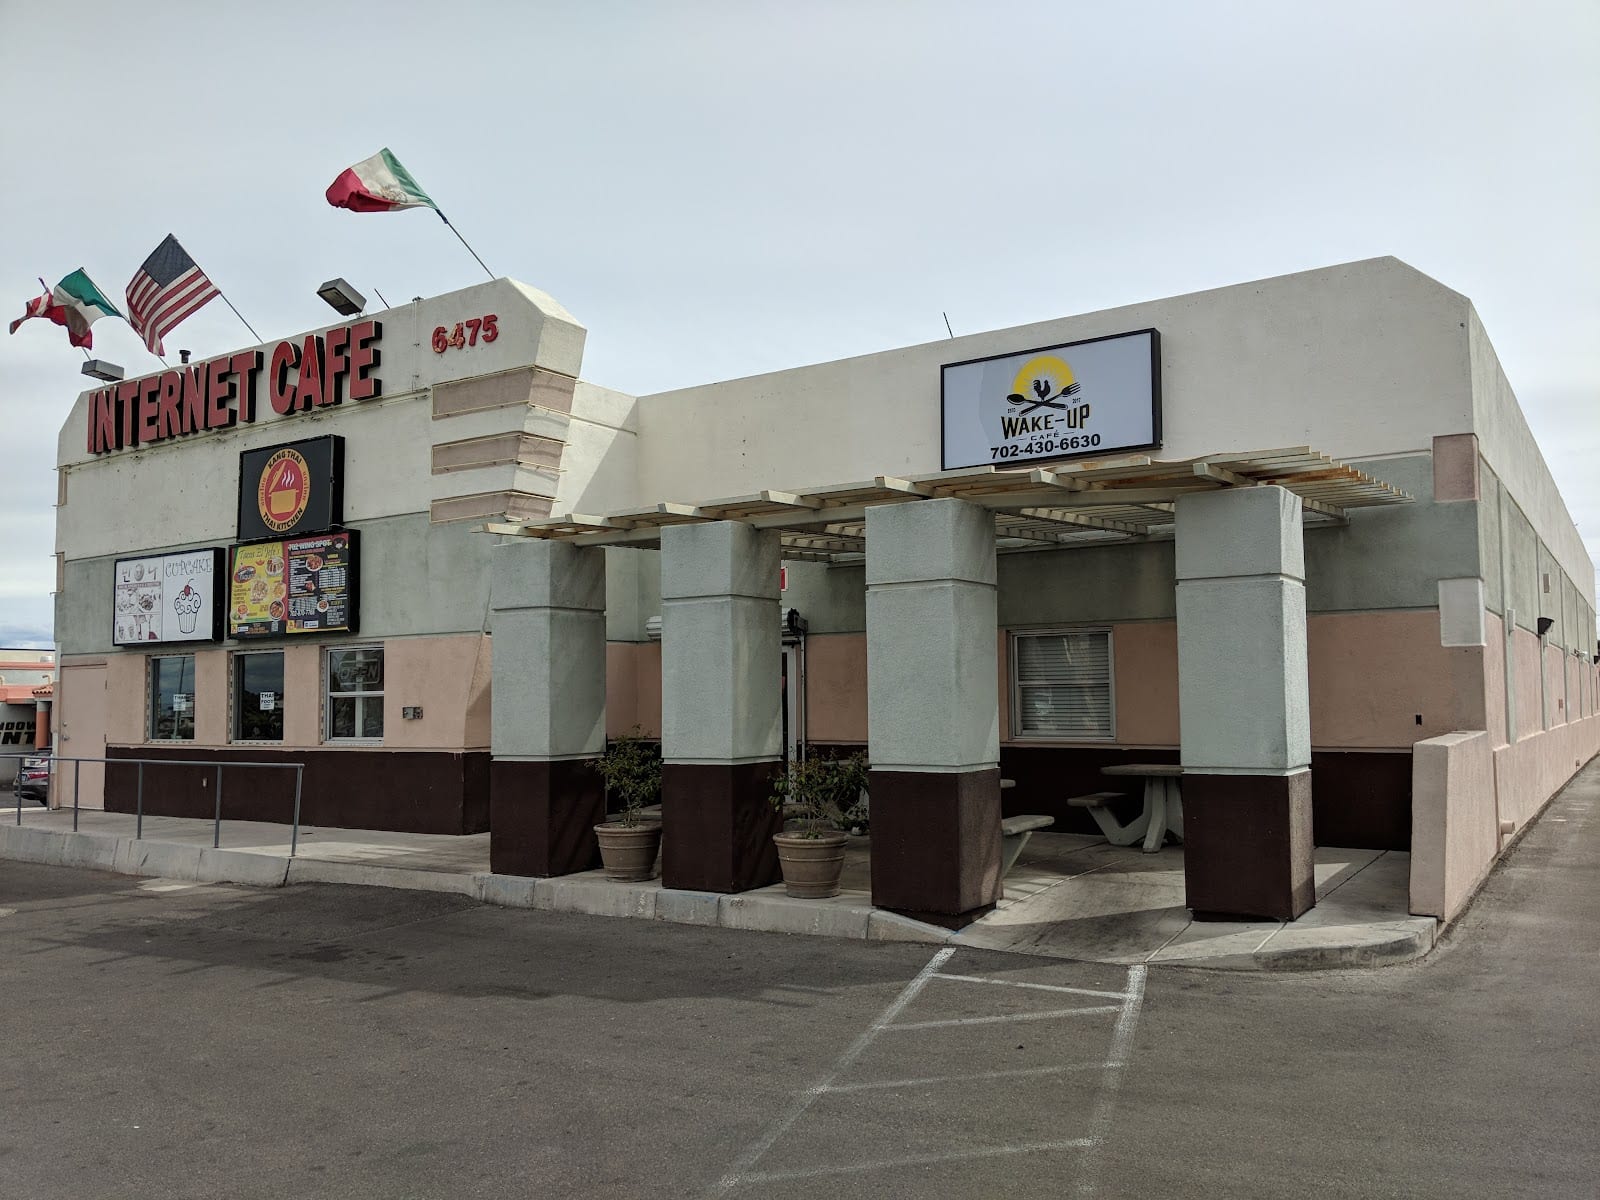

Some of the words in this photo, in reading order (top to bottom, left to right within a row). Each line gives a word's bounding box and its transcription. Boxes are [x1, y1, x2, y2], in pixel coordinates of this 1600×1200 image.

[431, 314, 499, 354] 6475
[87, 349, 264, 454] INTERNET
[269, 320, 382, 415] CAFE
[1000, 403, 1090, 440] WAKE-UP
[990, 433, 1101, 460] 702-430-6630
[268, 451, 286, 469] KANG
[287, 450, 303, 465] THAI
[263, 511, 276, 529] THAI
[276, 507, 303, 530] KITCHEN
[165, 558, 213, 578] CUPCAKE
[340, 664, 378, 680] OPEN
